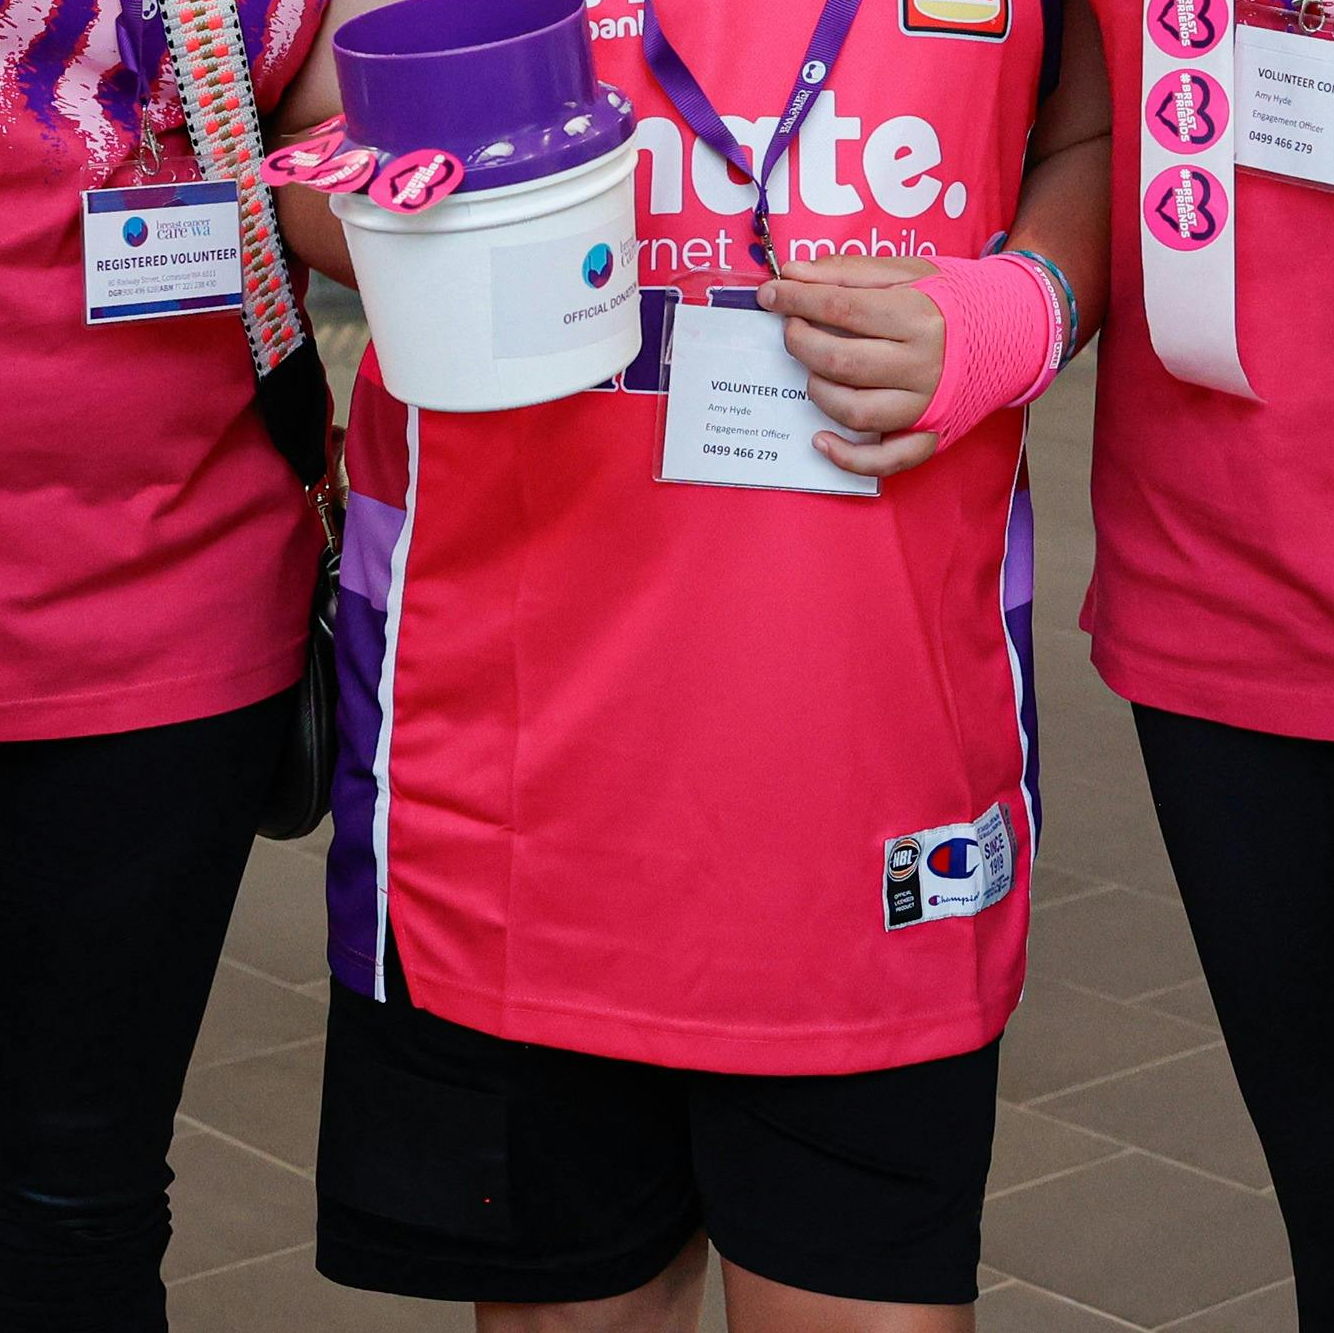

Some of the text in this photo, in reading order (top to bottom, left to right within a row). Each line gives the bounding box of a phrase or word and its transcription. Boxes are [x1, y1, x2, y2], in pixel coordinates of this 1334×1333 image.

[1258, 67, 1315, 89] VOLUNTEER
[1179, 72, 1198, 131] #BREAST
[1254, 90, 1292, 107] Amy Hyde
[1174, 91, 1191, 143] FRIENDS
[1252, 109, 1324, 134] Engagement Officer
[1249, 130, 1313, 155] 0499 466 279
[1179, 168, 1198, 227] #BREAST
[1174, 187, 1191, 239] FRIENDS
[156, 225, 211, 240] care wa
[96, 247, 238, 272] REGISTERED VOLUNTEER
[1033, 266, 1062, 324] STRONGER
[563, 302, 608, 324] OFFICIAL
[711, 380, 811, 401] VOLUNTEER CON
[708, 403, 752, 415] Amy Hyde
[705, 423, 790, 440] Engagement Officer
[702, 443, 778, 461] 0499 466 279
[892, 849, 914, 869] NBL
